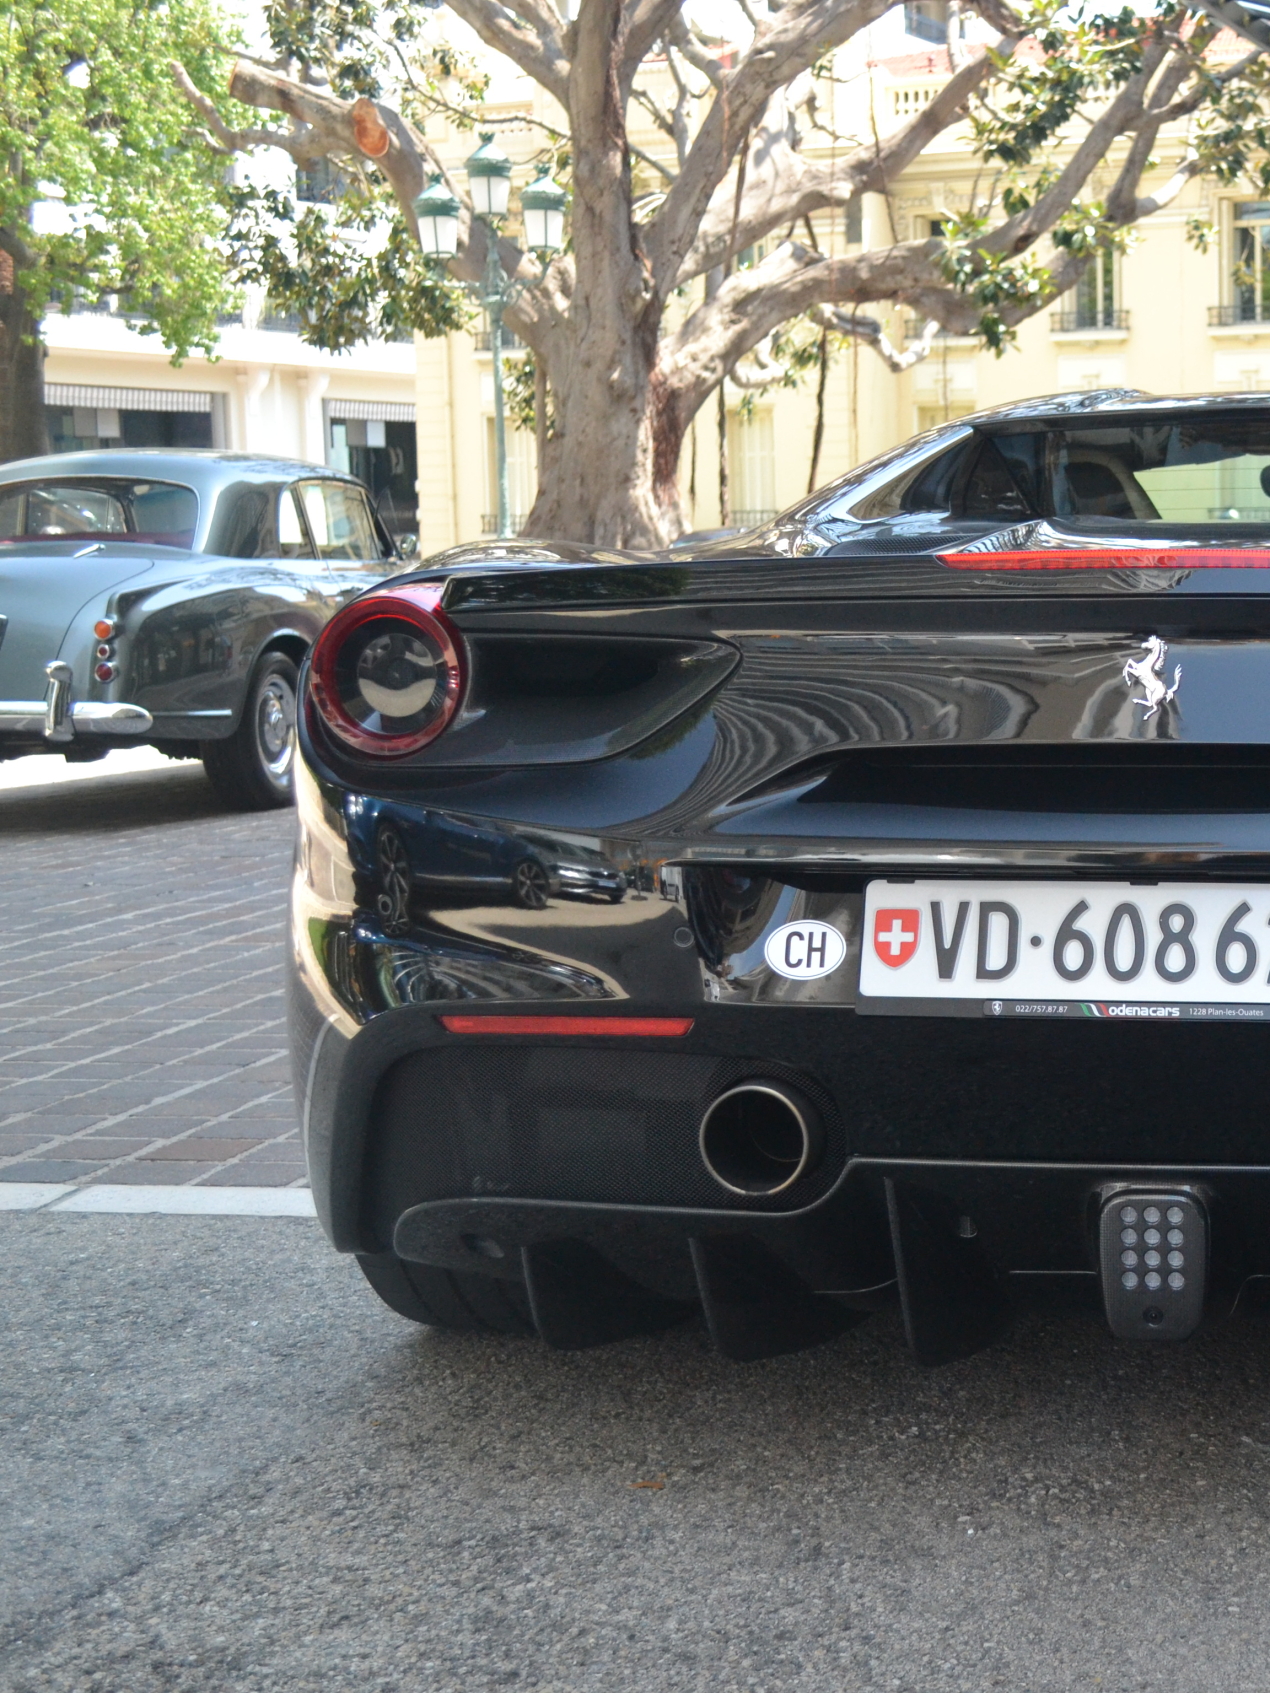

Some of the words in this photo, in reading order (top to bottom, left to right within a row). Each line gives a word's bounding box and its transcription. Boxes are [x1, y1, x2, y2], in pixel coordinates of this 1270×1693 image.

[784, 931, 826, 969] CH
[1015, 1004, 1068, 1013] 022/757.87.87
[1189, 1008, 1207, 1016] 1228
[1208, 1008, 1264, 1016] Plan-les-Ouates
